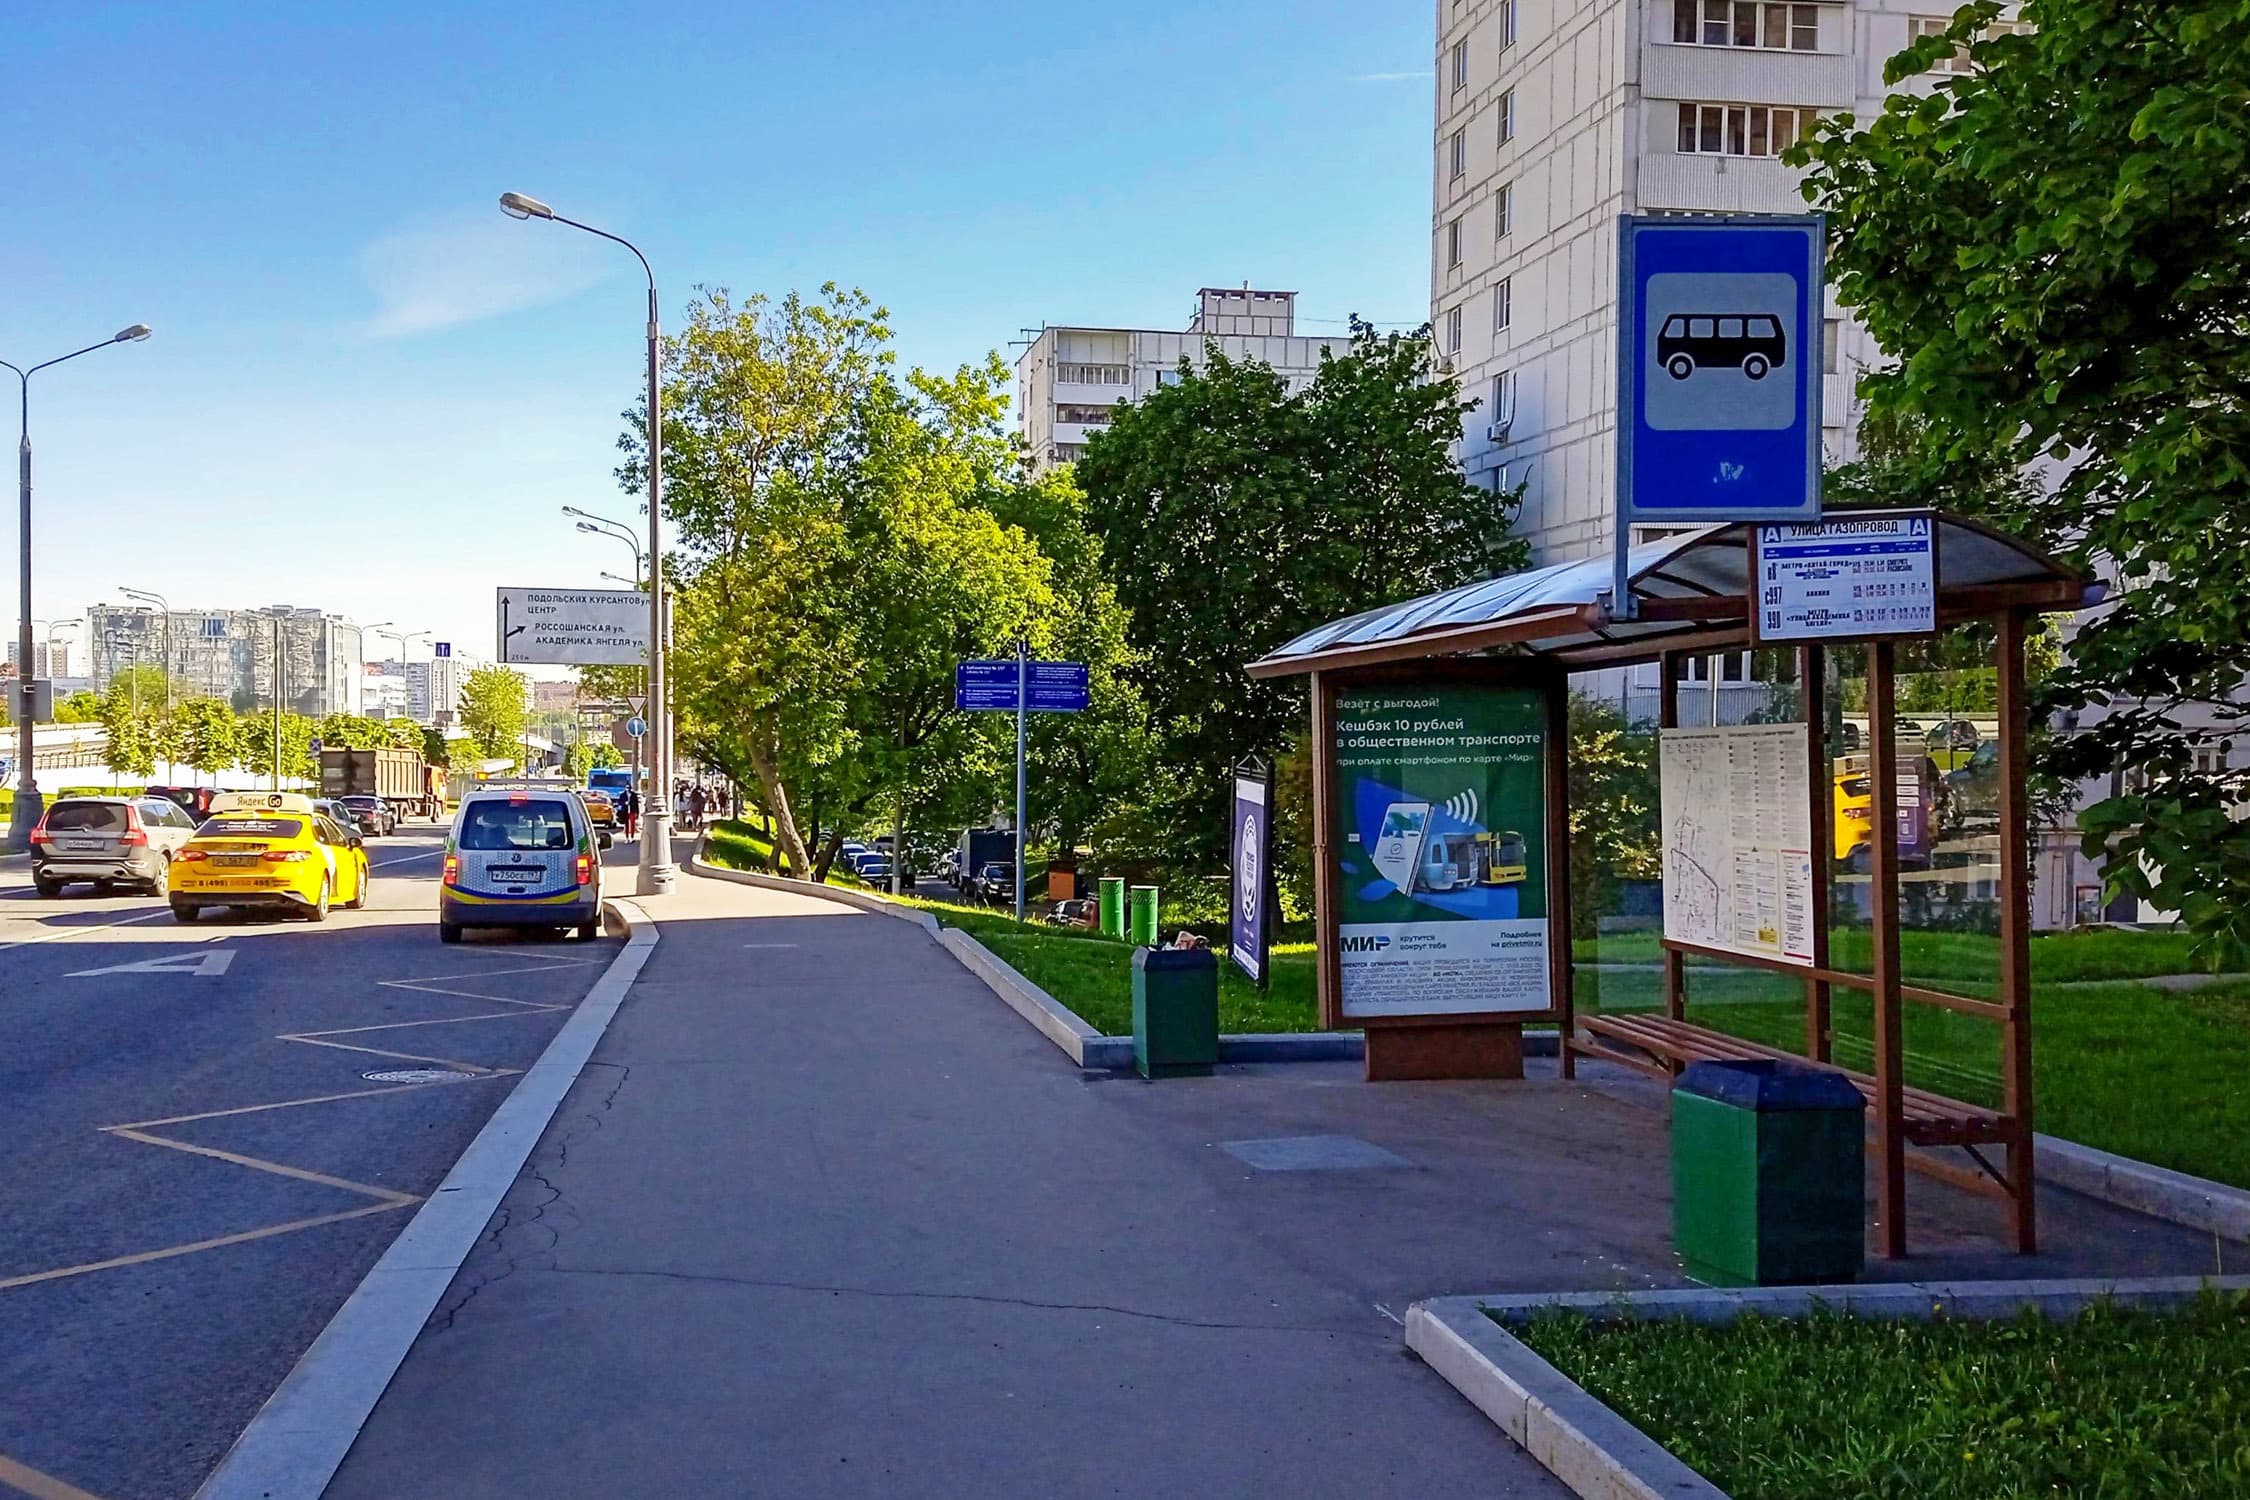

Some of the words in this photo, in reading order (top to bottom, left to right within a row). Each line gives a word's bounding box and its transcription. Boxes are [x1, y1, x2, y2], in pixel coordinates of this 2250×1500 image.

[1791, 525, 1826, 536] УЛИЦА
[1829, 521, 1898, 535] ГАЗОПРОВОД
[527, 594, 587, 604] ПОДОЛЬСКИХ
[589, 596, 640, 605] КУРСАНТОВ
[527, 606, 557, 614] ЦЕНТР
[535, 622, 610, 632] РОССОШАНСКАЯ
[612, 625, 625, 634] ул.
[536, 636, 593, 646] АКАДЕМИКА
[595, 638, 630, 647] ЯНГЕЛЯ
[632, 639, 645, 648] ул.
[1374, 700, 1381, 708] с
[1383, 697, 1440, 709] выгодой!
[1336, 720, 1392, 732] Кешбэк
[1394, 720, 1410, 731] 10
[1414, 716, 1464, 732] рублей
[1336, 738, 1345, 748] в
[1348, 736, 1455, 749] общественном
[1458, 734, 1541, 748] транспорте
[1336, 758, 1355, 767] при
[1356, 757, 1392, 766] оплате
[1393, 756, 1456, 766] смартфоном
[1459, 756, 1472, 764] по
[1473, 754, 1503, 763] карте
[237, 796, 266, 806] Яндекс
[269, 796, 281, 807] Go
[1341, 935, 1391, 952] МИР
[1400, 935, 1435, 943] крутится
[1500, 931, 1542, 939] Подробнее
[1400, 942, 1427, 951] вокруг
[1501, 940, 1543, 949] privetmir.ru
